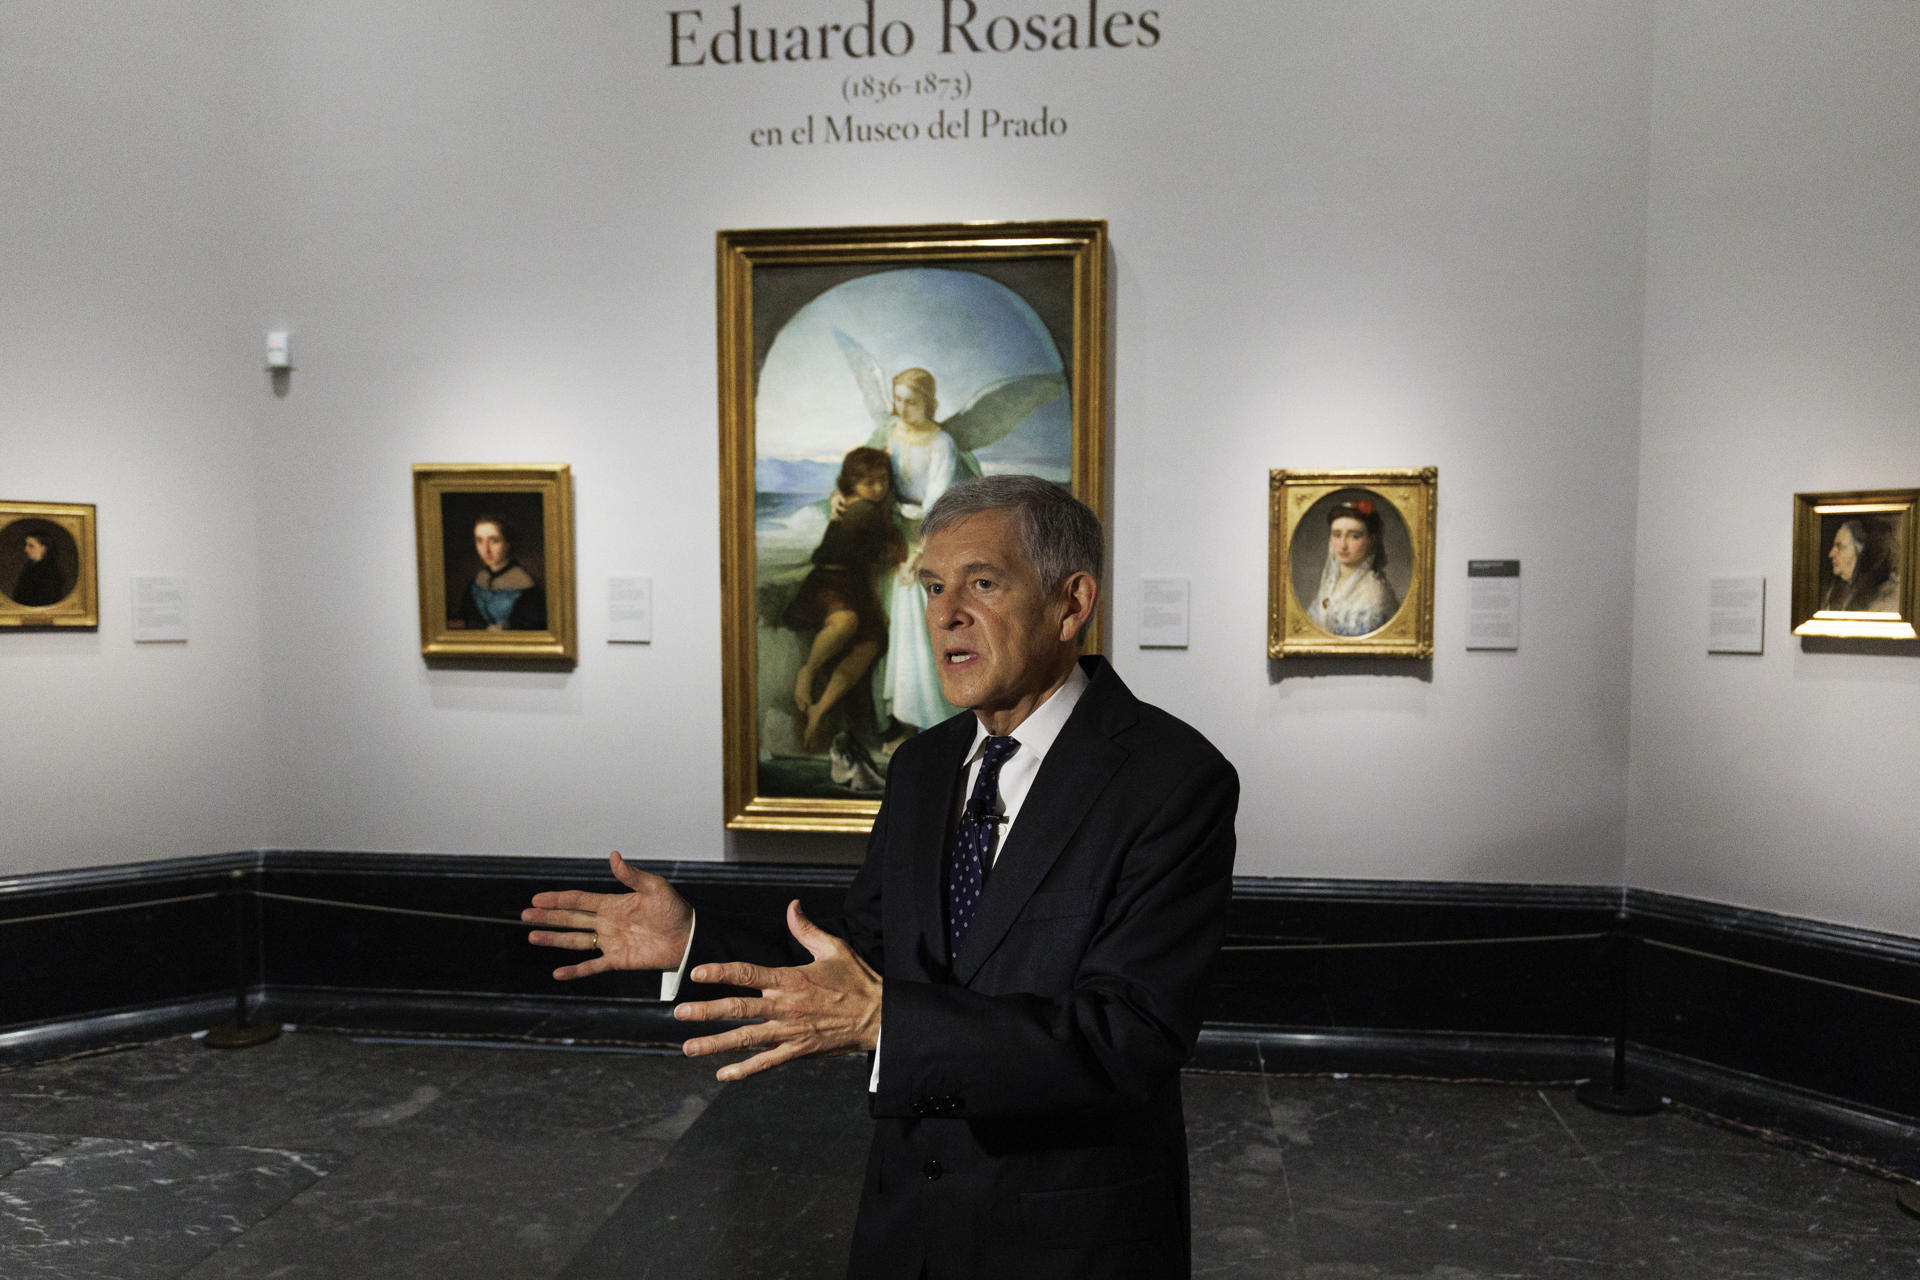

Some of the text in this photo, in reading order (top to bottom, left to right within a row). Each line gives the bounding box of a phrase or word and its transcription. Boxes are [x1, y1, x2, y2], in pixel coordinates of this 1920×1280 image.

[667, 0, 1161, 67] Eduardo Rosales
[750, 106, 1068, 147] en el Museo del Prado
